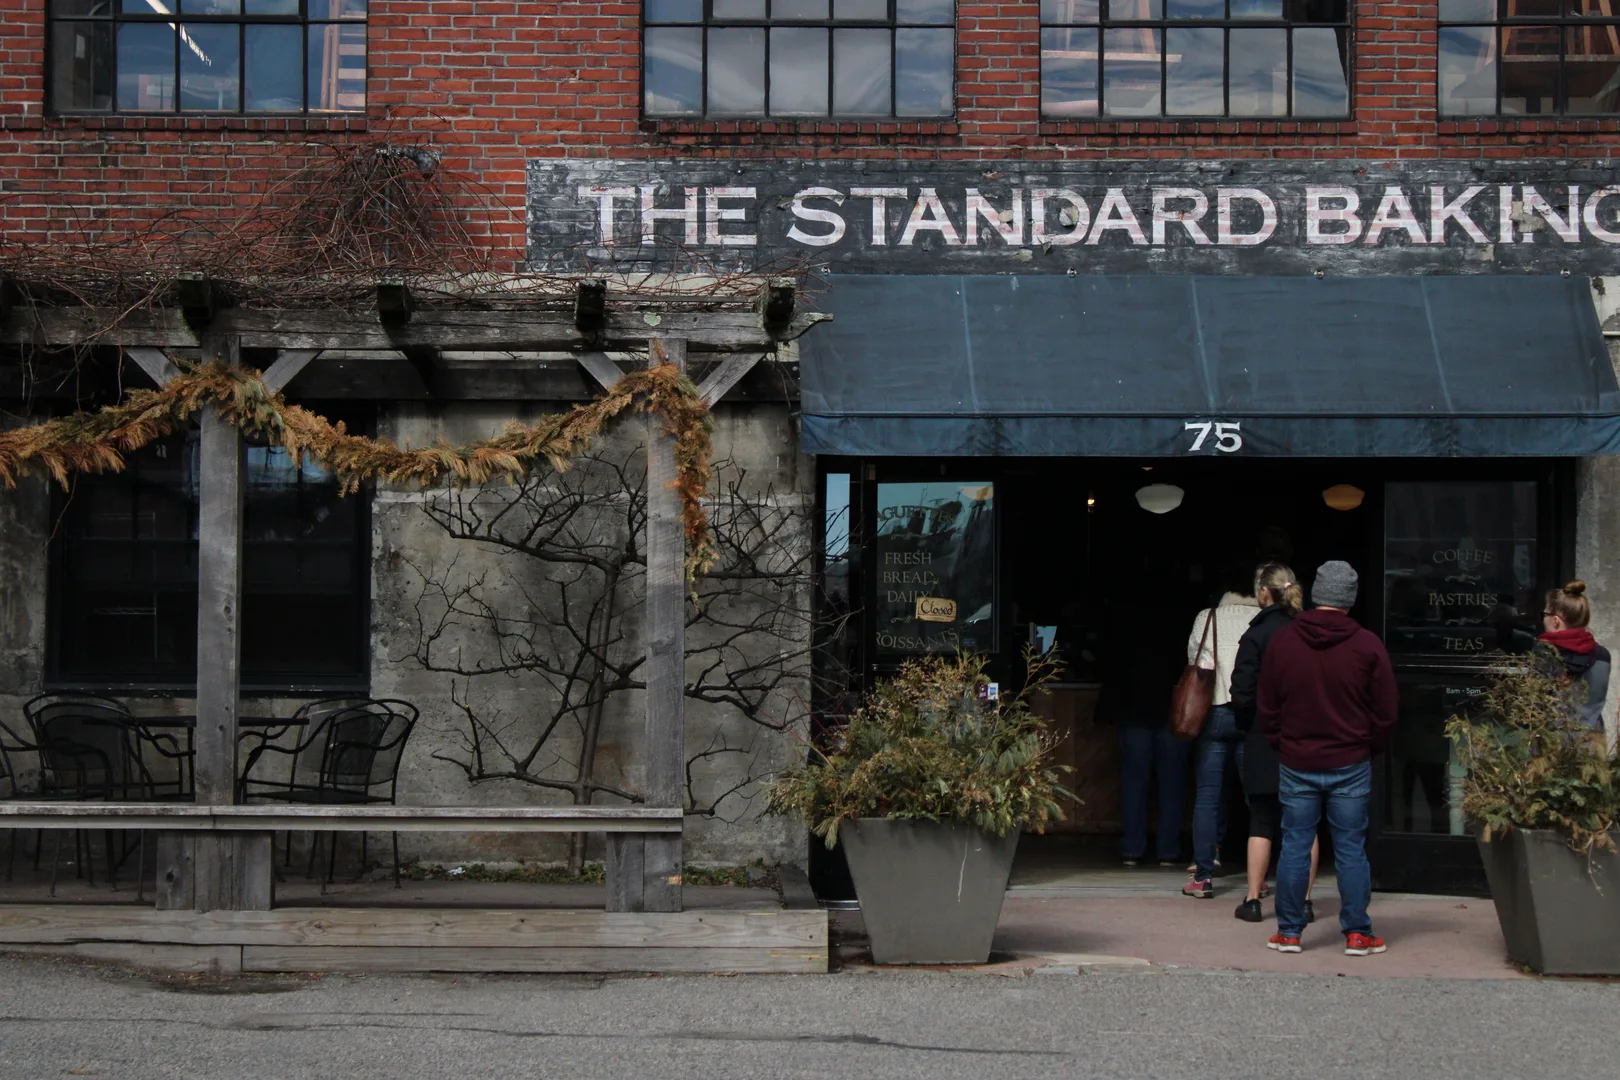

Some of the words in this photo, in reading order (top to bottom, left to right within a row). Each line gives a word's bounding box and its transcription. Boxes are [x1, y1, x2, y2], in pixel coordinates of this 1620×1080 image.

[577, 186, 757, 246] THE
[786, 186, 1278, 247] STANDARD
[1184, 421, 1242, 452] 75
[884, 552, 932, 565] FRESH
[1432, 548, 1493, 564] COFFEE
[883, 571, 934, 584] BREAD
[1428, 592, 1498, 606] PASTRIES
[920, 599, 953, 616] Closed
[1442, 636, 1484, 650] TEAS
[1445, 687, 1461, 695] 8am
[1465, 687, 1482, 697] 5pm
